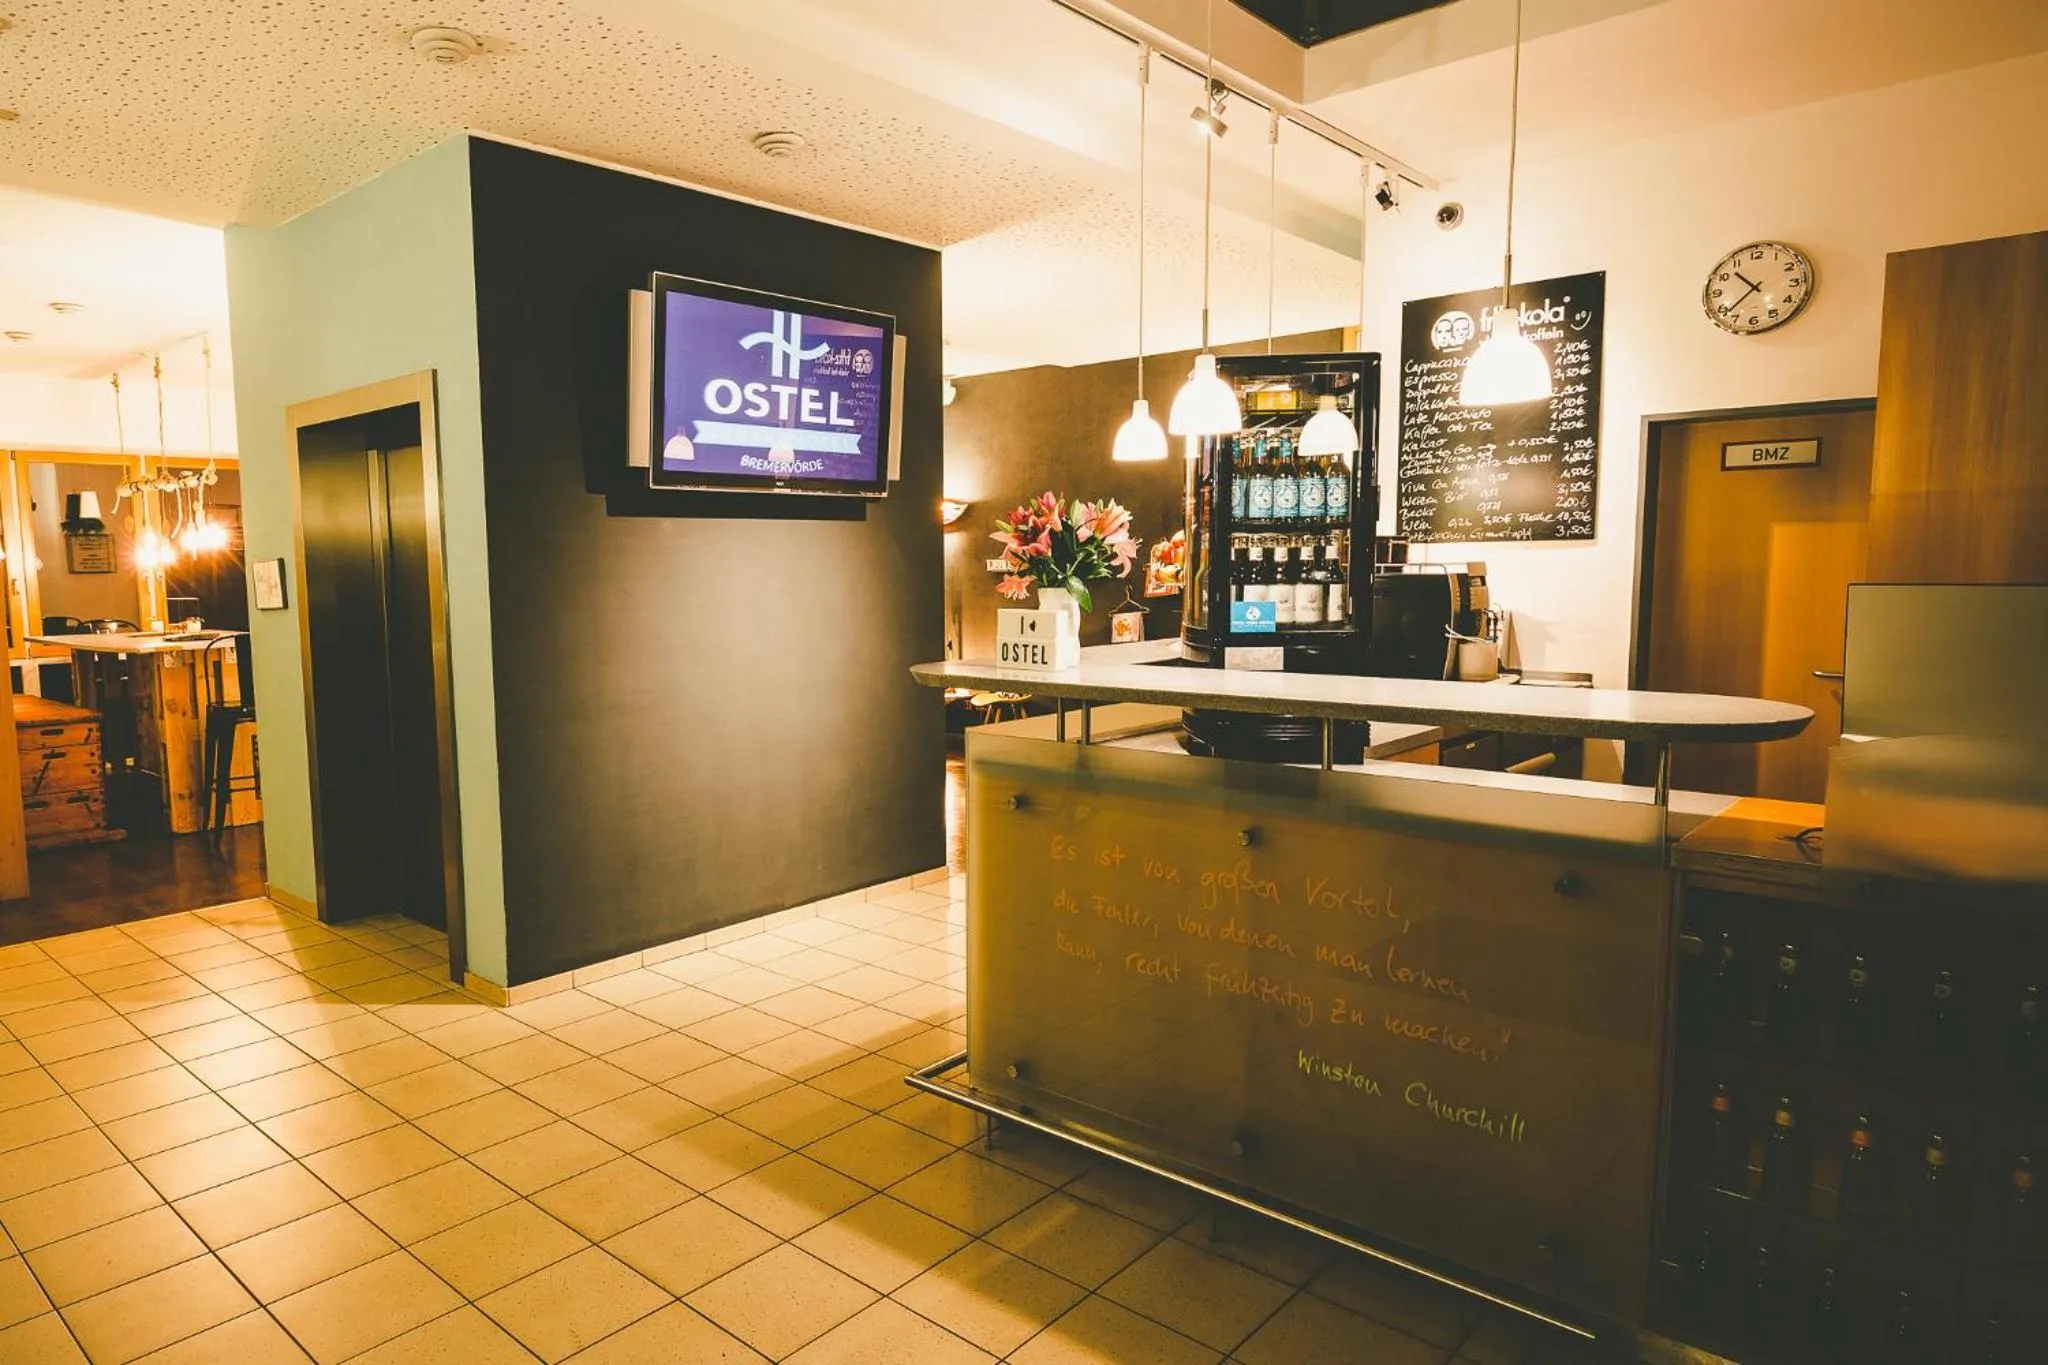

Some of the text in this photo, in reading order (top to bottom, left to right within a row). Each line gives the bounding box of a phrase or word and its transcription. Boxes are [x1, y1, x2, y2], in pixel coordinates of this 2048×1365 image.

[1750, 251, 1763, 260] 12
[1734, 259, 1740, 268] 11
[1784, 262, 1794, 272] 2
[1719, 272, 1729, 281] 10
[1789, 278, 1800, 287] 3
[1712, 289, 1722, 298] 9
[1783, 295, 1792, 303] 4
[1768, 309, 1778, 318] 5
[1732, 314, 1739, 324] 7
[1749, 316, 1759, 325] 6
[704, 379, 854, 427] OSTEL
[1753, 447, 1790, 461] BMZ
[740, 454, 824, 473] BREMERVÖRDE
[1021, 616, 1024, 634] I
[1002, 643, 1048, 665] OSTEL
[1404, 1081, 1525, 1144] Churchill
